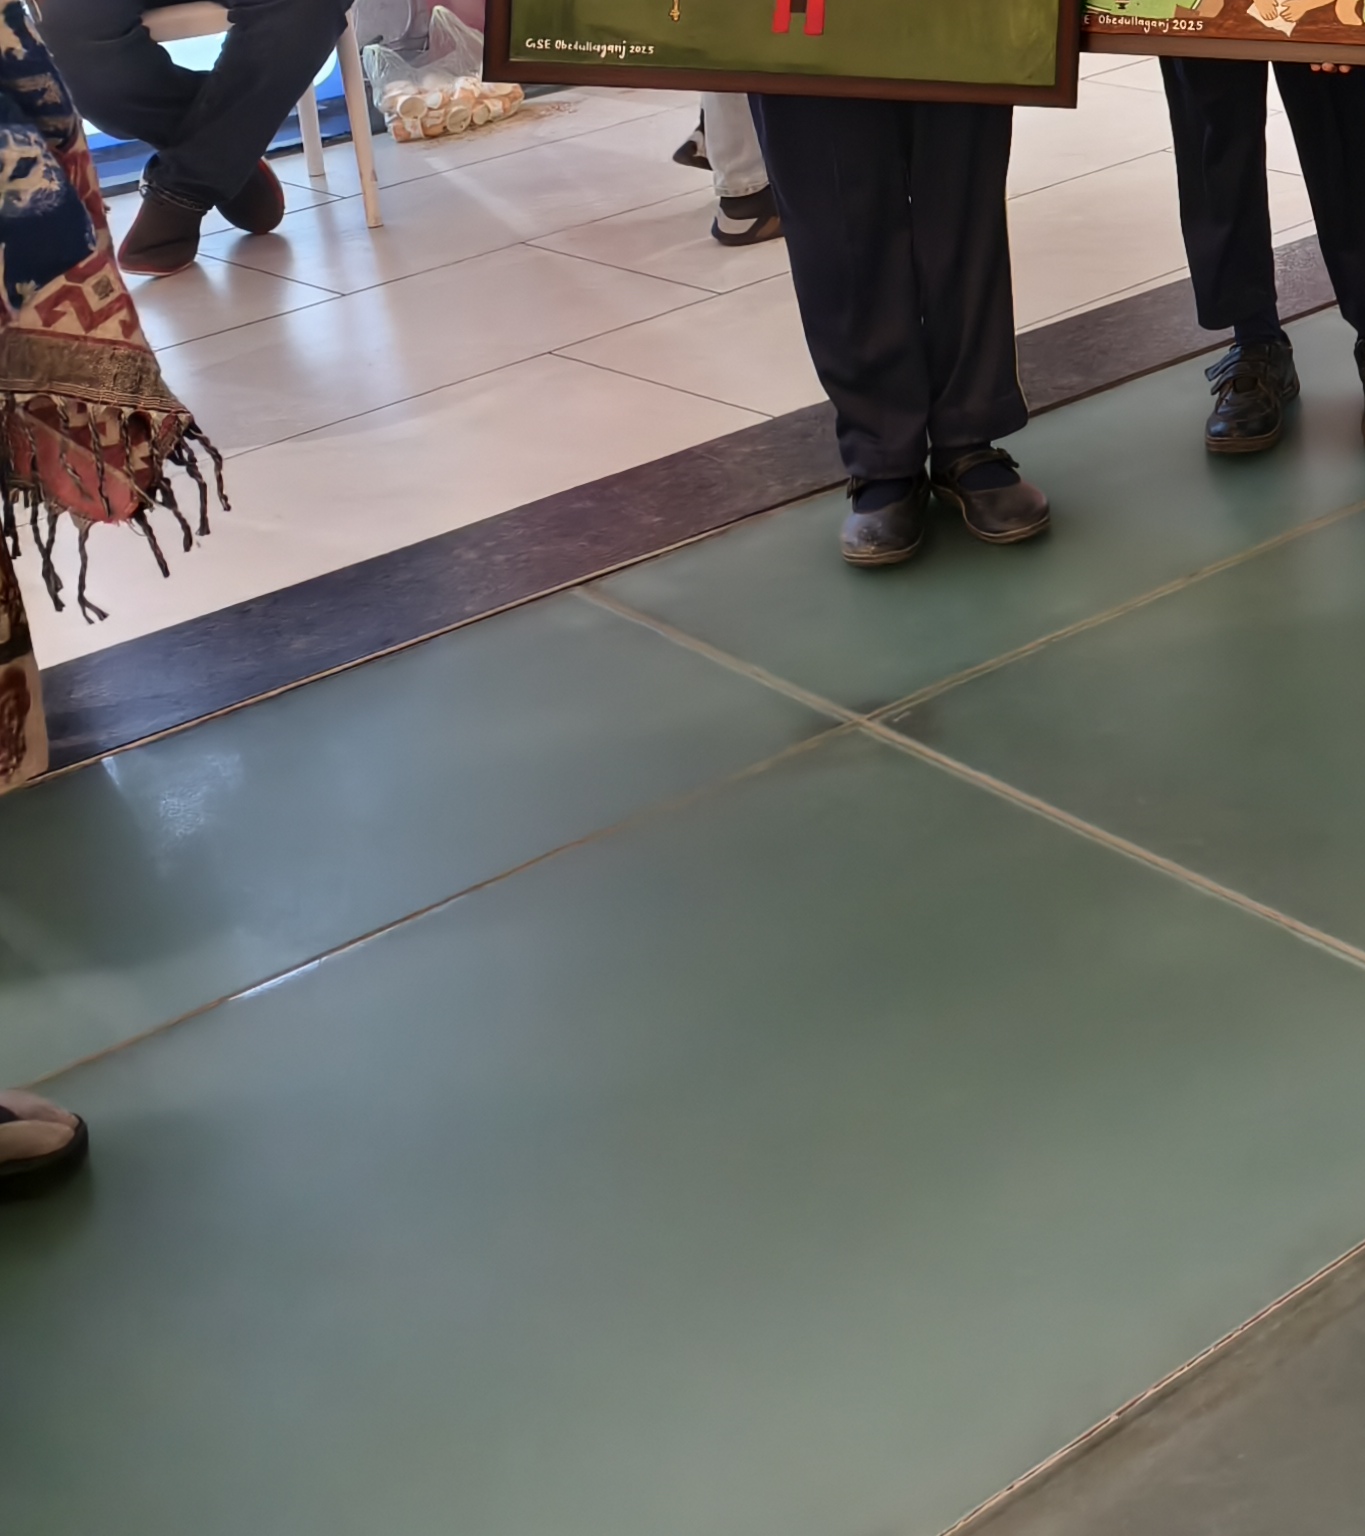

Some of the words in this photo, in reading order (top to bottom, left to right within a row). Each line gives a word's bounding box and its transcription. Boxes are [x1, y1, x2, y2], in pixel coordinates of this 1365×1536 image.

[1098, 15, 1170, 33] Obedullaganj
[1172, 19, 1203, 31] 2025
[525, 37, 551, 50] GSE
[554, 38, 627, 59] Obedullaganj
[629, 45, 655, 55] 2025
